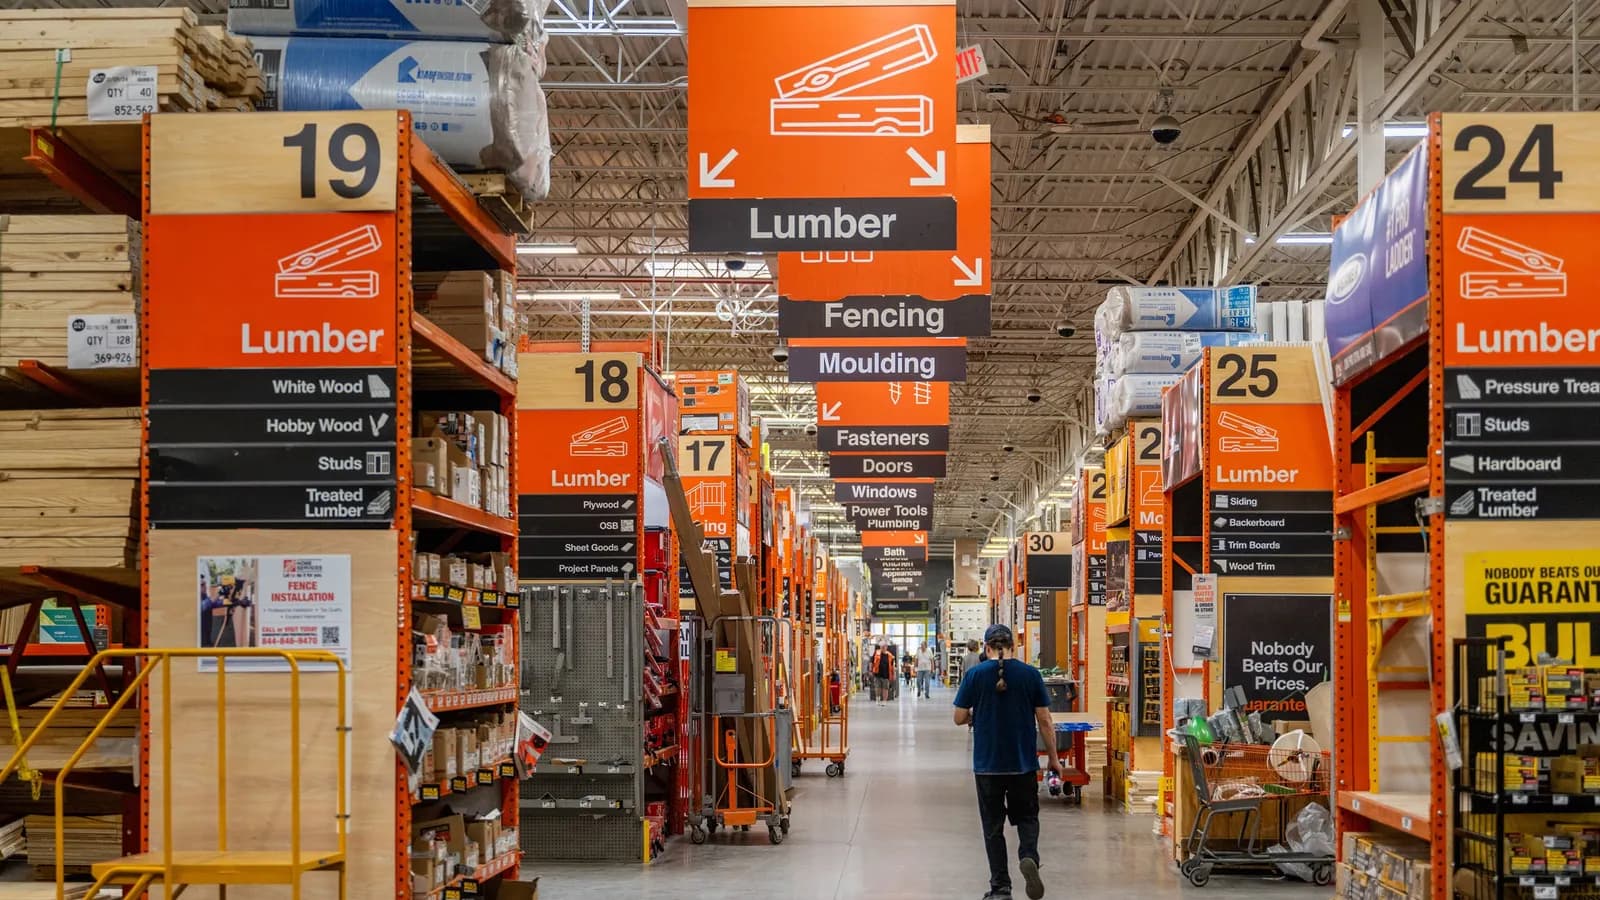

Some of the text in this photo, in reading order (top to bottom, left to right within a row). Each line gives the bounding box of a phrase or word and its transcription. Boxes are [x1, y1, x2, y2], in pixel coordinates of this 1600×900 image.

[107, 88, 151, 97] QTY 40
[283, 123, 381, 199] 19
[1454, 124, 1563, 200] 24
[751, 207, 896, 238] Lumber
[1385, 231, 1414, 279] LADDER
[825, 303, 944, 333] Fencing
[87, 336, 131, 346] QTY 128
[241, 323, 384, 354] Lumber
[1457, 323, 1600, 352] Lumber
[95, 353, 131, 363] 369-926
[819, 352, 935, 378] Moulding
[575, 360, 629, 403] 18
[1217, 354, 1278, 397] 25
[272, 380, 363, 394] White Wood
[1486, 379, 1600, 394] Pressure Trea
[267, 419, 362, 435] Hobby Wood
[1485, 418, 1529, 431] Studs
[837, 430, 929, 445] Fasteners
[686, 440, 725, 471] 17
[318, 456, 362, 470] Studs
[863, 459, 913, 472] Doors
[1478, 456, 1561, 470] Hardboard
[552, 470, 630, 487] Lumber
[1217, 465, 1298, 483] Lumber
[306, 488, 363, 502] Treated
[852, 485, 917, 498] Windows
[1478, 487, 1536, 501] Treated
[584, 500, 618, 510] Plywood
[1230, 498, 1257, 507] Siding
[1478, 503, 1538, 516] Lumber
[305, 503, 363, 517] Lumber
[852, 505, 928, 516] Power Tools
[600, 522, 618, 530] OSB
[704, 519, 727, 534] ing
[868, 519, 919, 529] Plumbing
[1229, 518, 1285, 527] Backerboard
[565, 543, 618, 552] Sheet Goods
[1030, 535, 1053, 551] 30
[1228, 541, 1280, 550] Trim Boards
[884, 548, 905, 556] Bath
[559, 564, 618, 574] Project Panels
[1229, 562, 1275, 571] Wood Trim
[1485, 567, 1600, 579] NOBODY BEATS OU
[288, 581, 317, 590] FENCE
[271, 592, 334, 601] INSTALLATION
[1251, 641, 1314, 658] Nobody
[1242, 659, 1323, 673] Beats Our
[1255, 676, 1309, 690] Prices.
[1489, 722, 1600, 751] SAVIN
